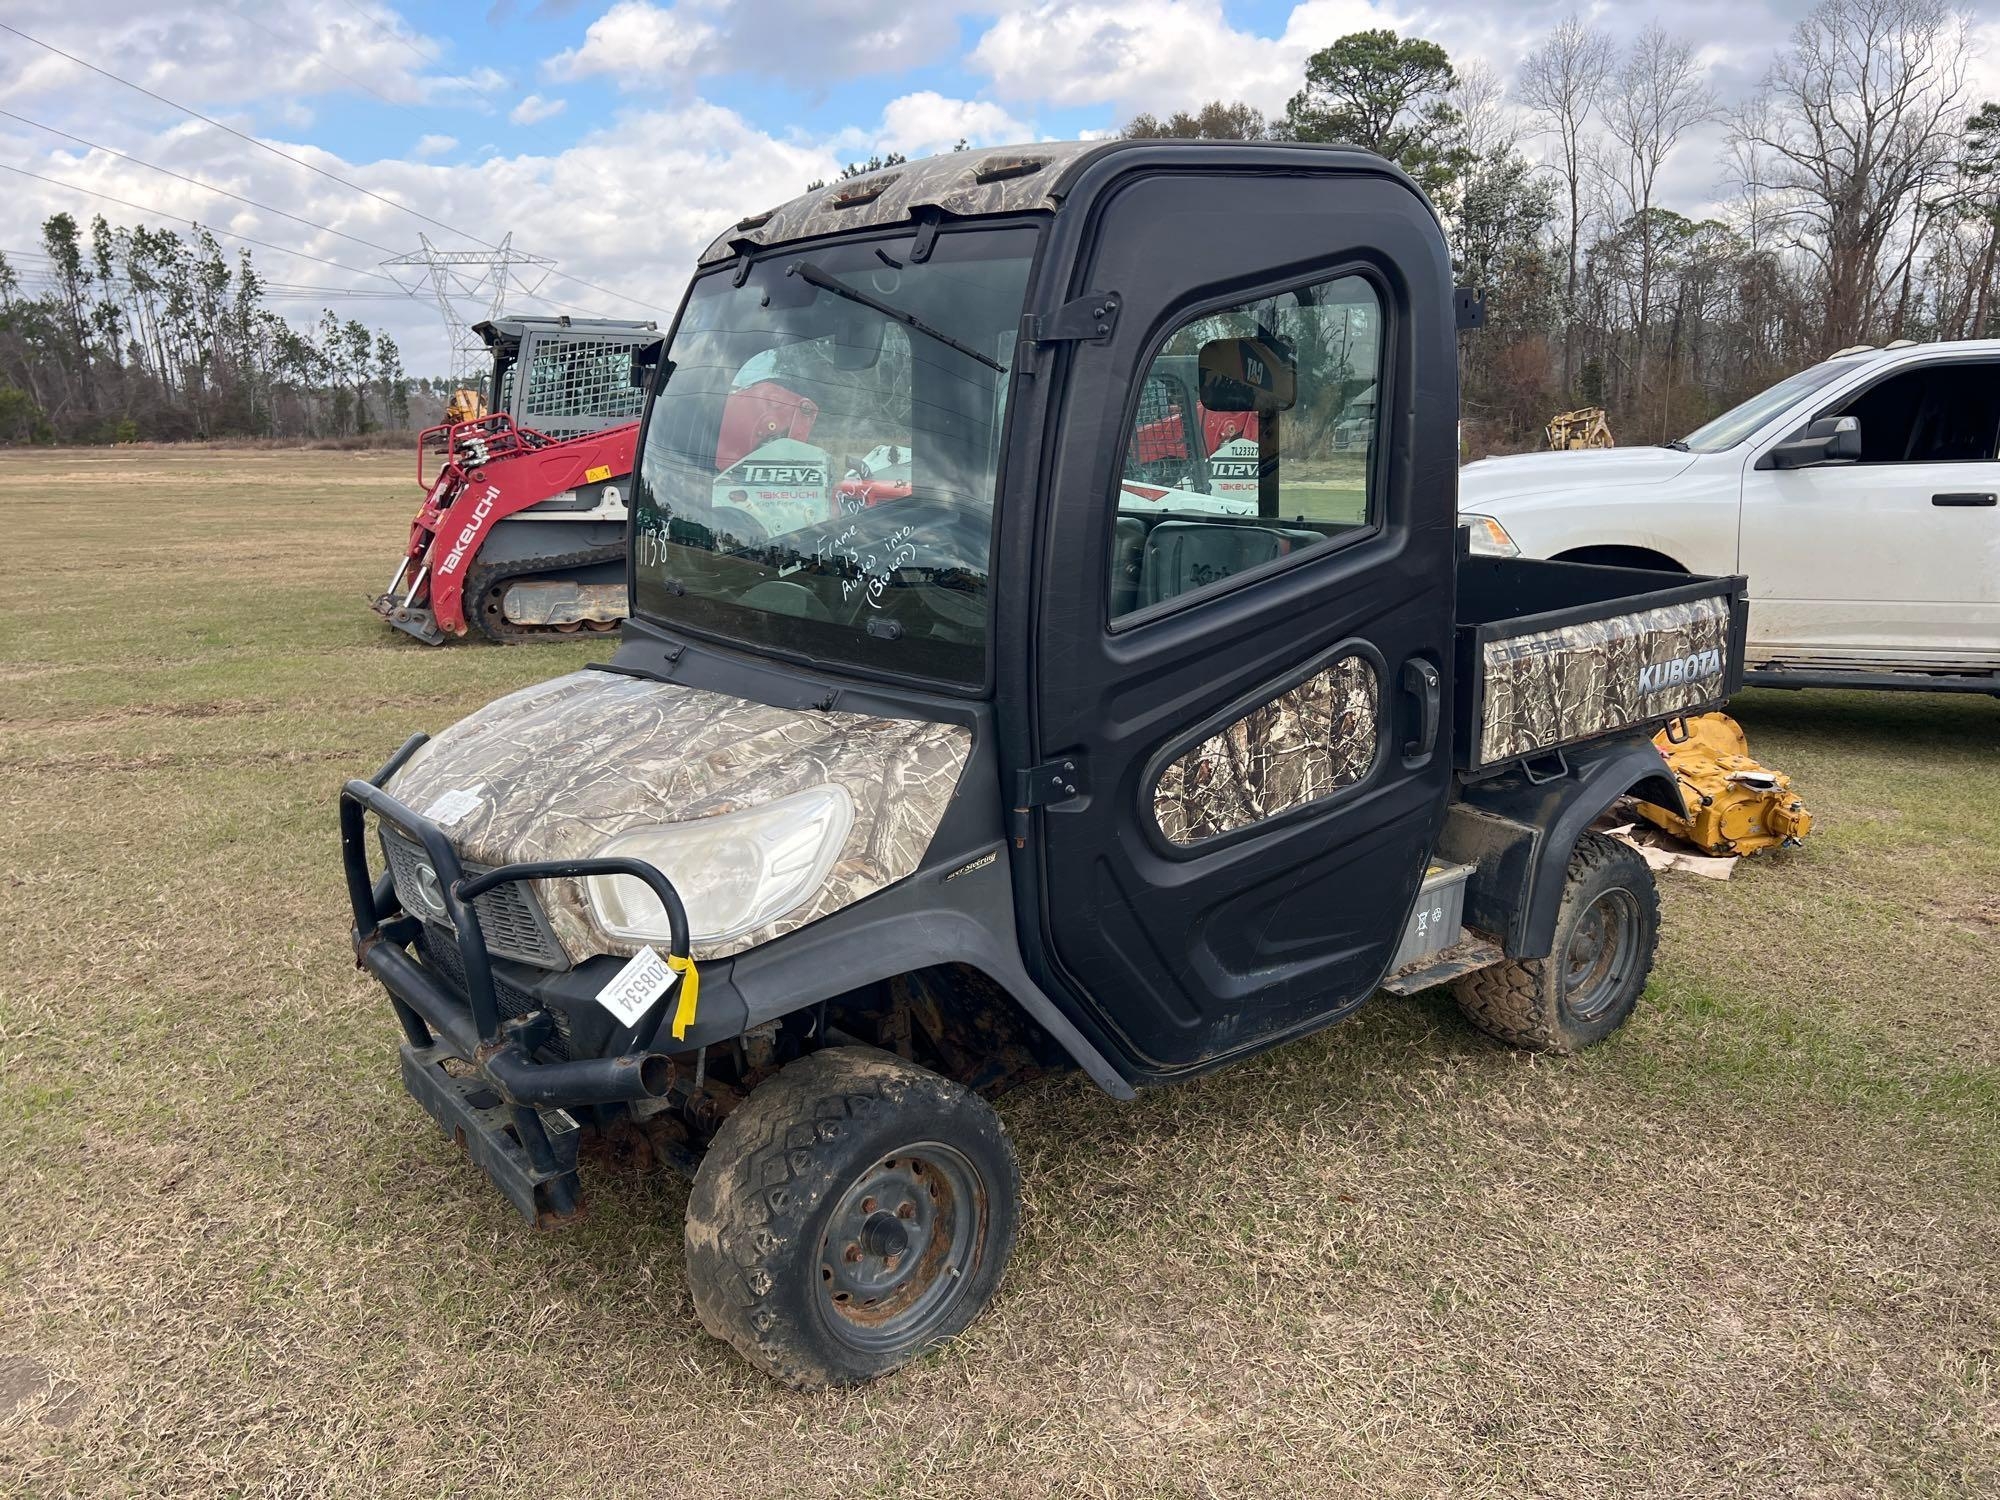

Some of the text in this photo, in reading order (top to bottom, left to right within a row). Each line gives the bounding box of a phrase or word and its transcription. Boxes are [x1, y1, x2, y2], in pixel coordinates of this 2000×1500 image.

[743, 465, 821, 482] TL12V2
[1212, 462, 1259, 476] TL12V
[438, 485, 501, 576] TAKEUCHI
[640, 520, 671, 567] 1138
[817, 524, 859, 567] Frame
[1491, 636, 1577, 663] DIESEL
[1637, 647, 1721, 698] KUBOTA
[617, 959, 669, 1013] 208534
